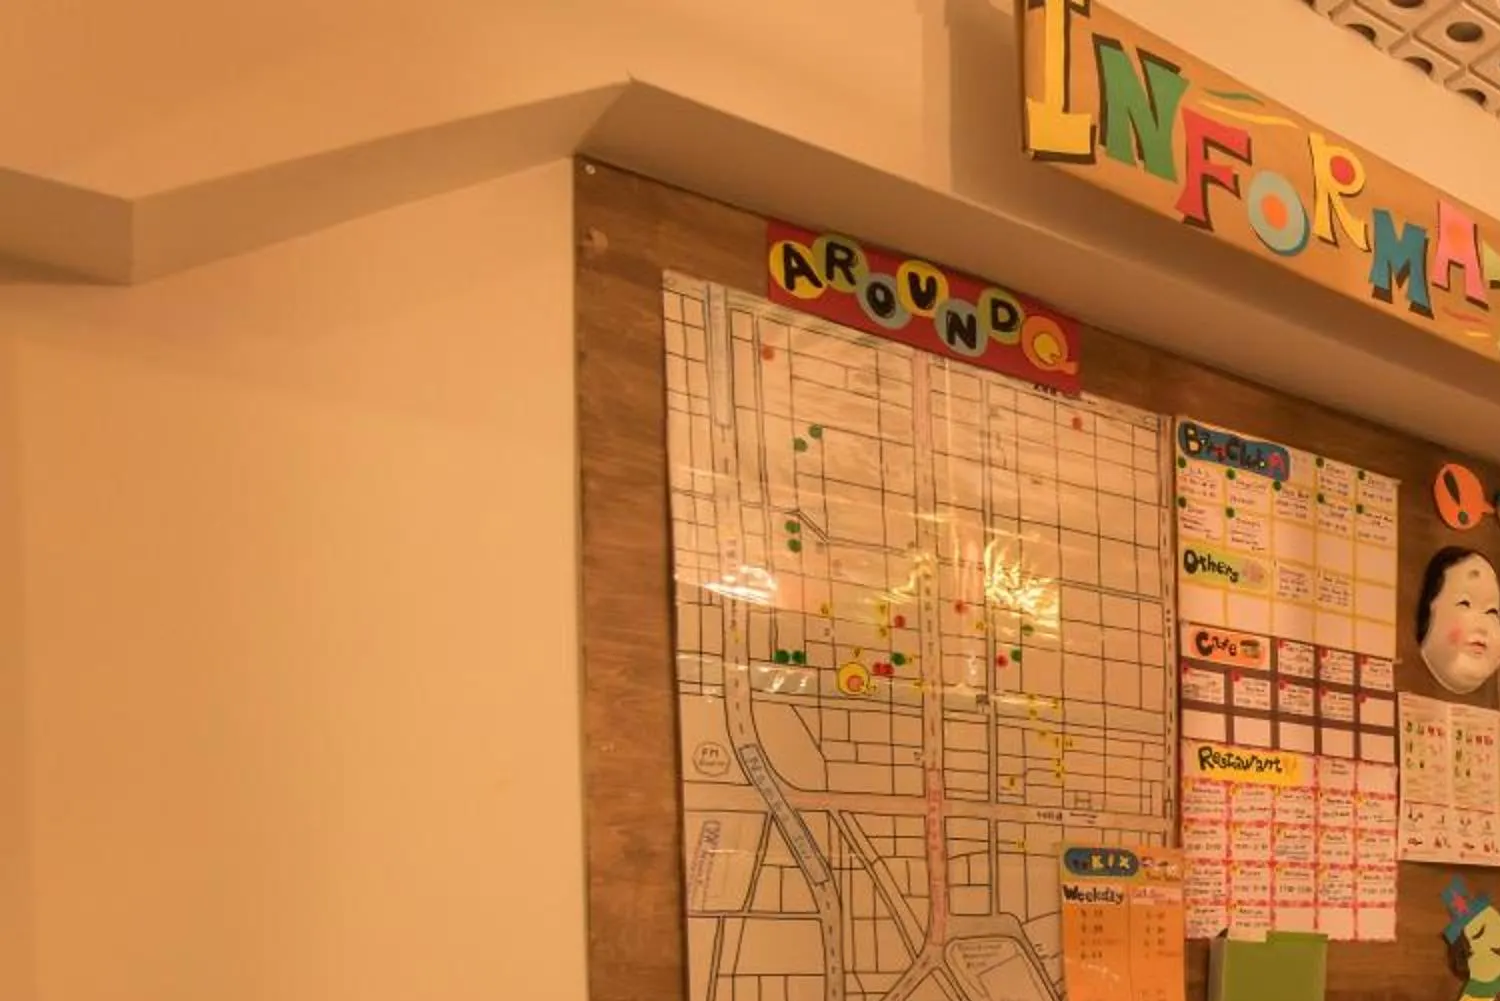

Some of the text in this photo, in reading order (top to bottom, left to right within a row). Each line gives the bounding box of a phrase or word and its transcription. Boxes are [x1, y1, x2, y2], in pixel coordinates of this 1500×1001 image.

[781, 240, 1021, 350] AROUND
[1183, 549, 1239, 583] Others
[1195, 631, 1237, 656] Cafe
[1198, 746, 1283, 772] Restaurant
